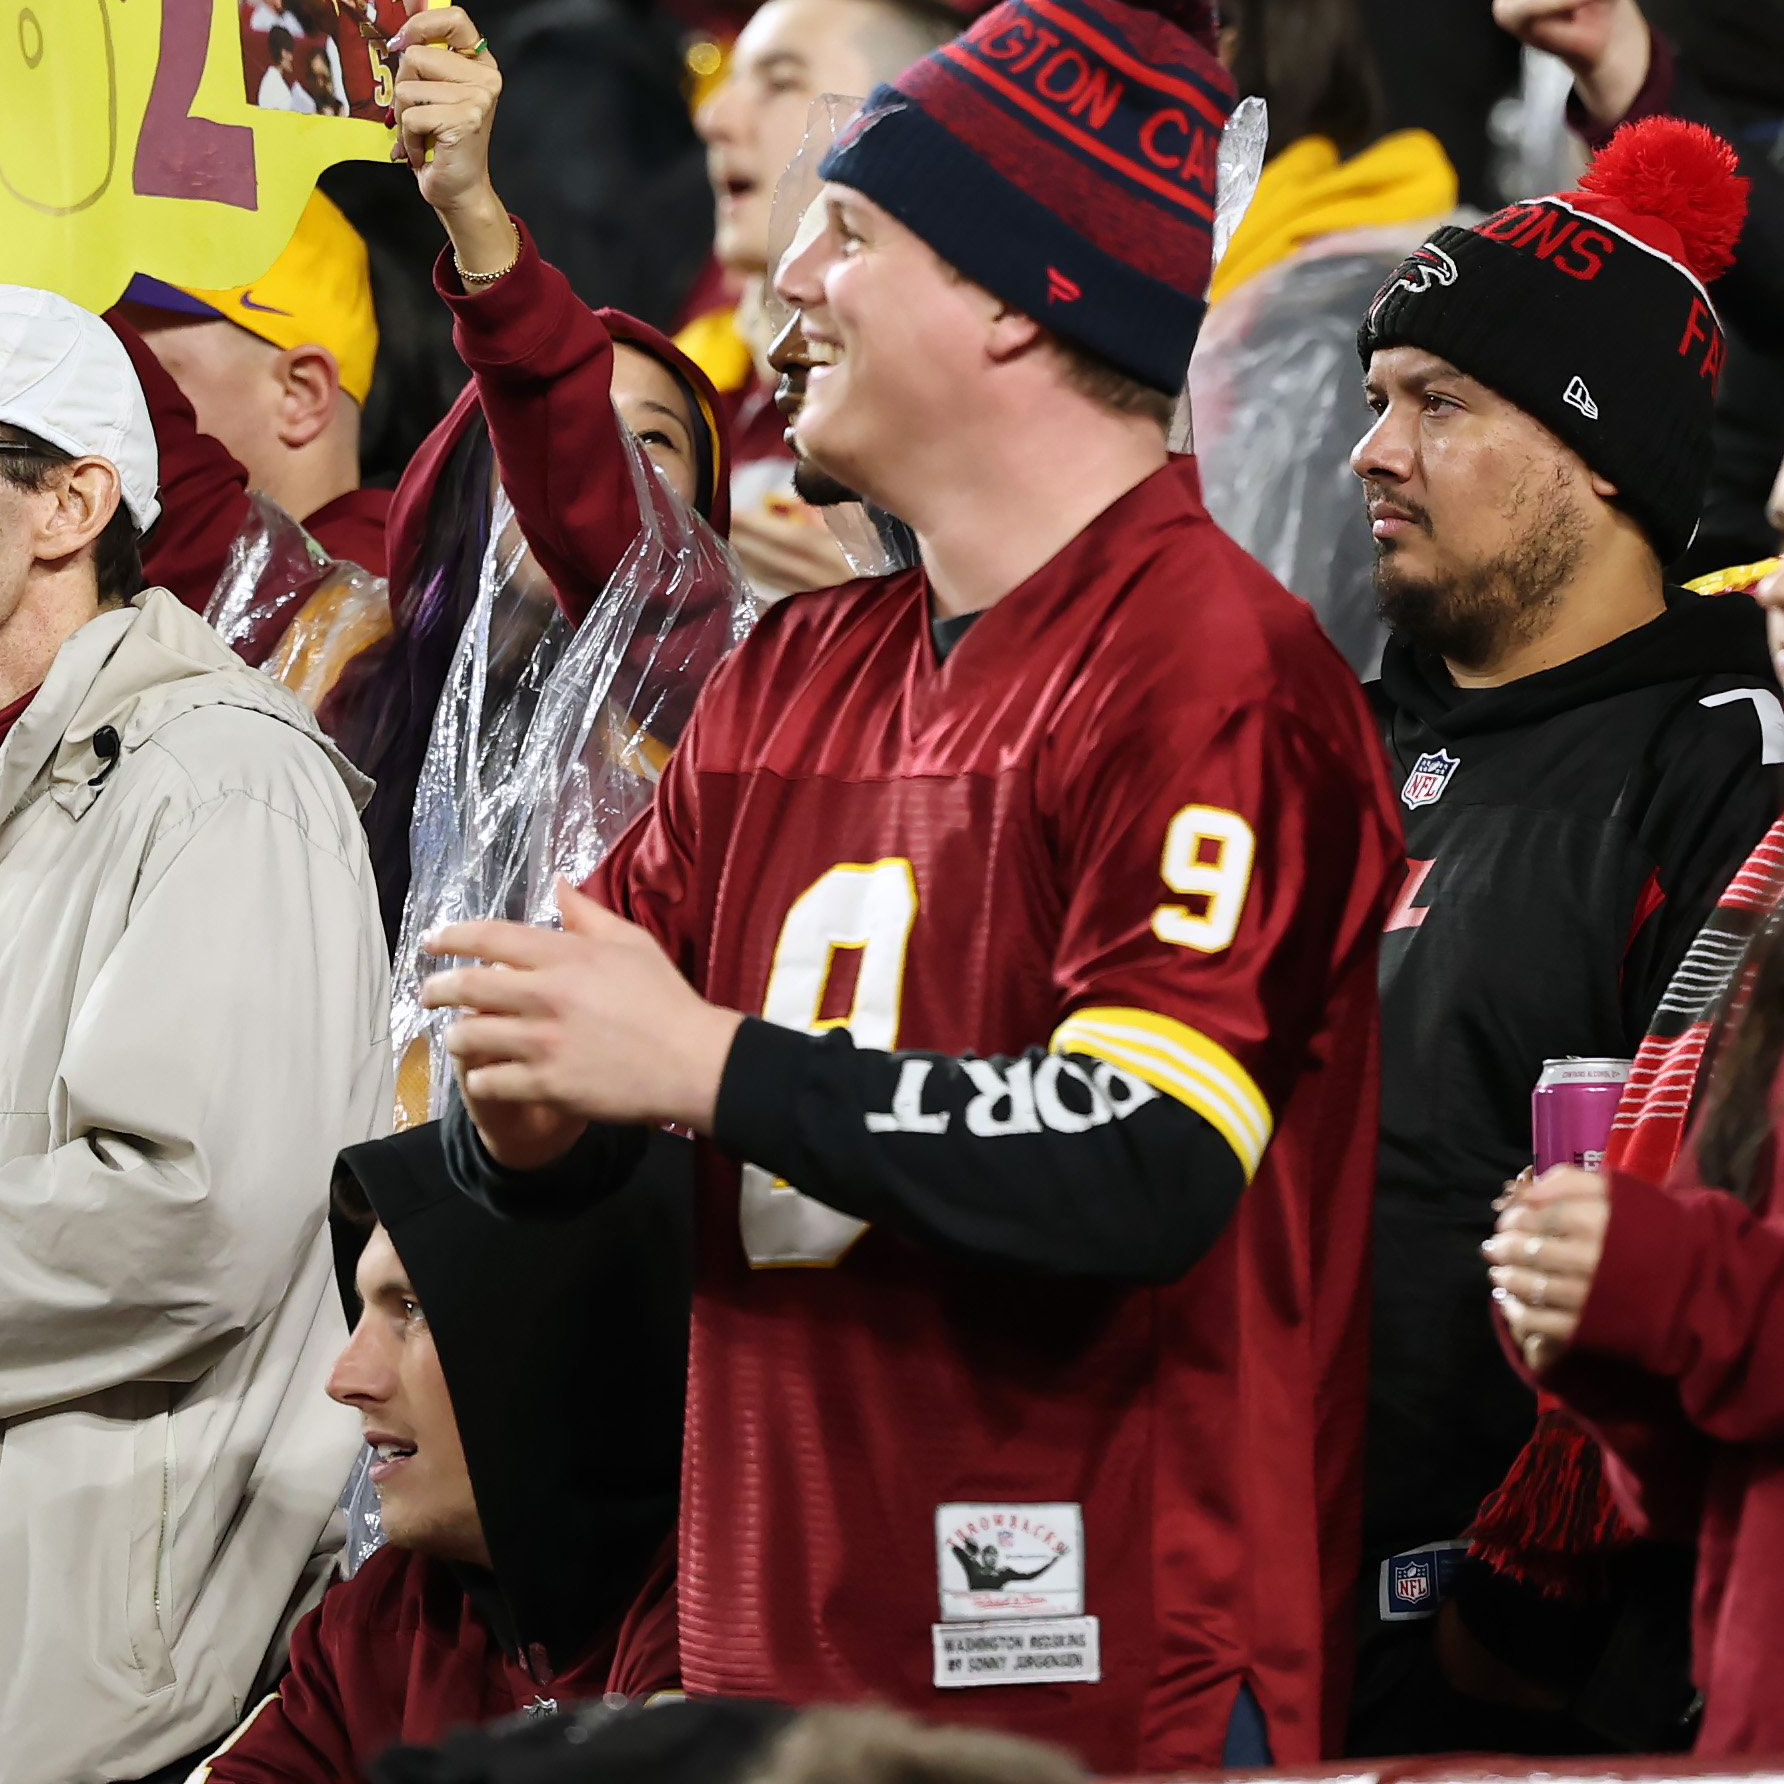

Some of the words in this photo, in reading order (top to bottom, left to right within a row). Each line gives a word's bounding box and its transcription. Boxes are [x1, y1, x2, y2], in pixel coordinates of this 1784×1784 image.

[1406, 774, 1439, 800] NFL
[1150, 803, 1256, 954] 9
[1399, 1578, 1427, 1598] NFL
